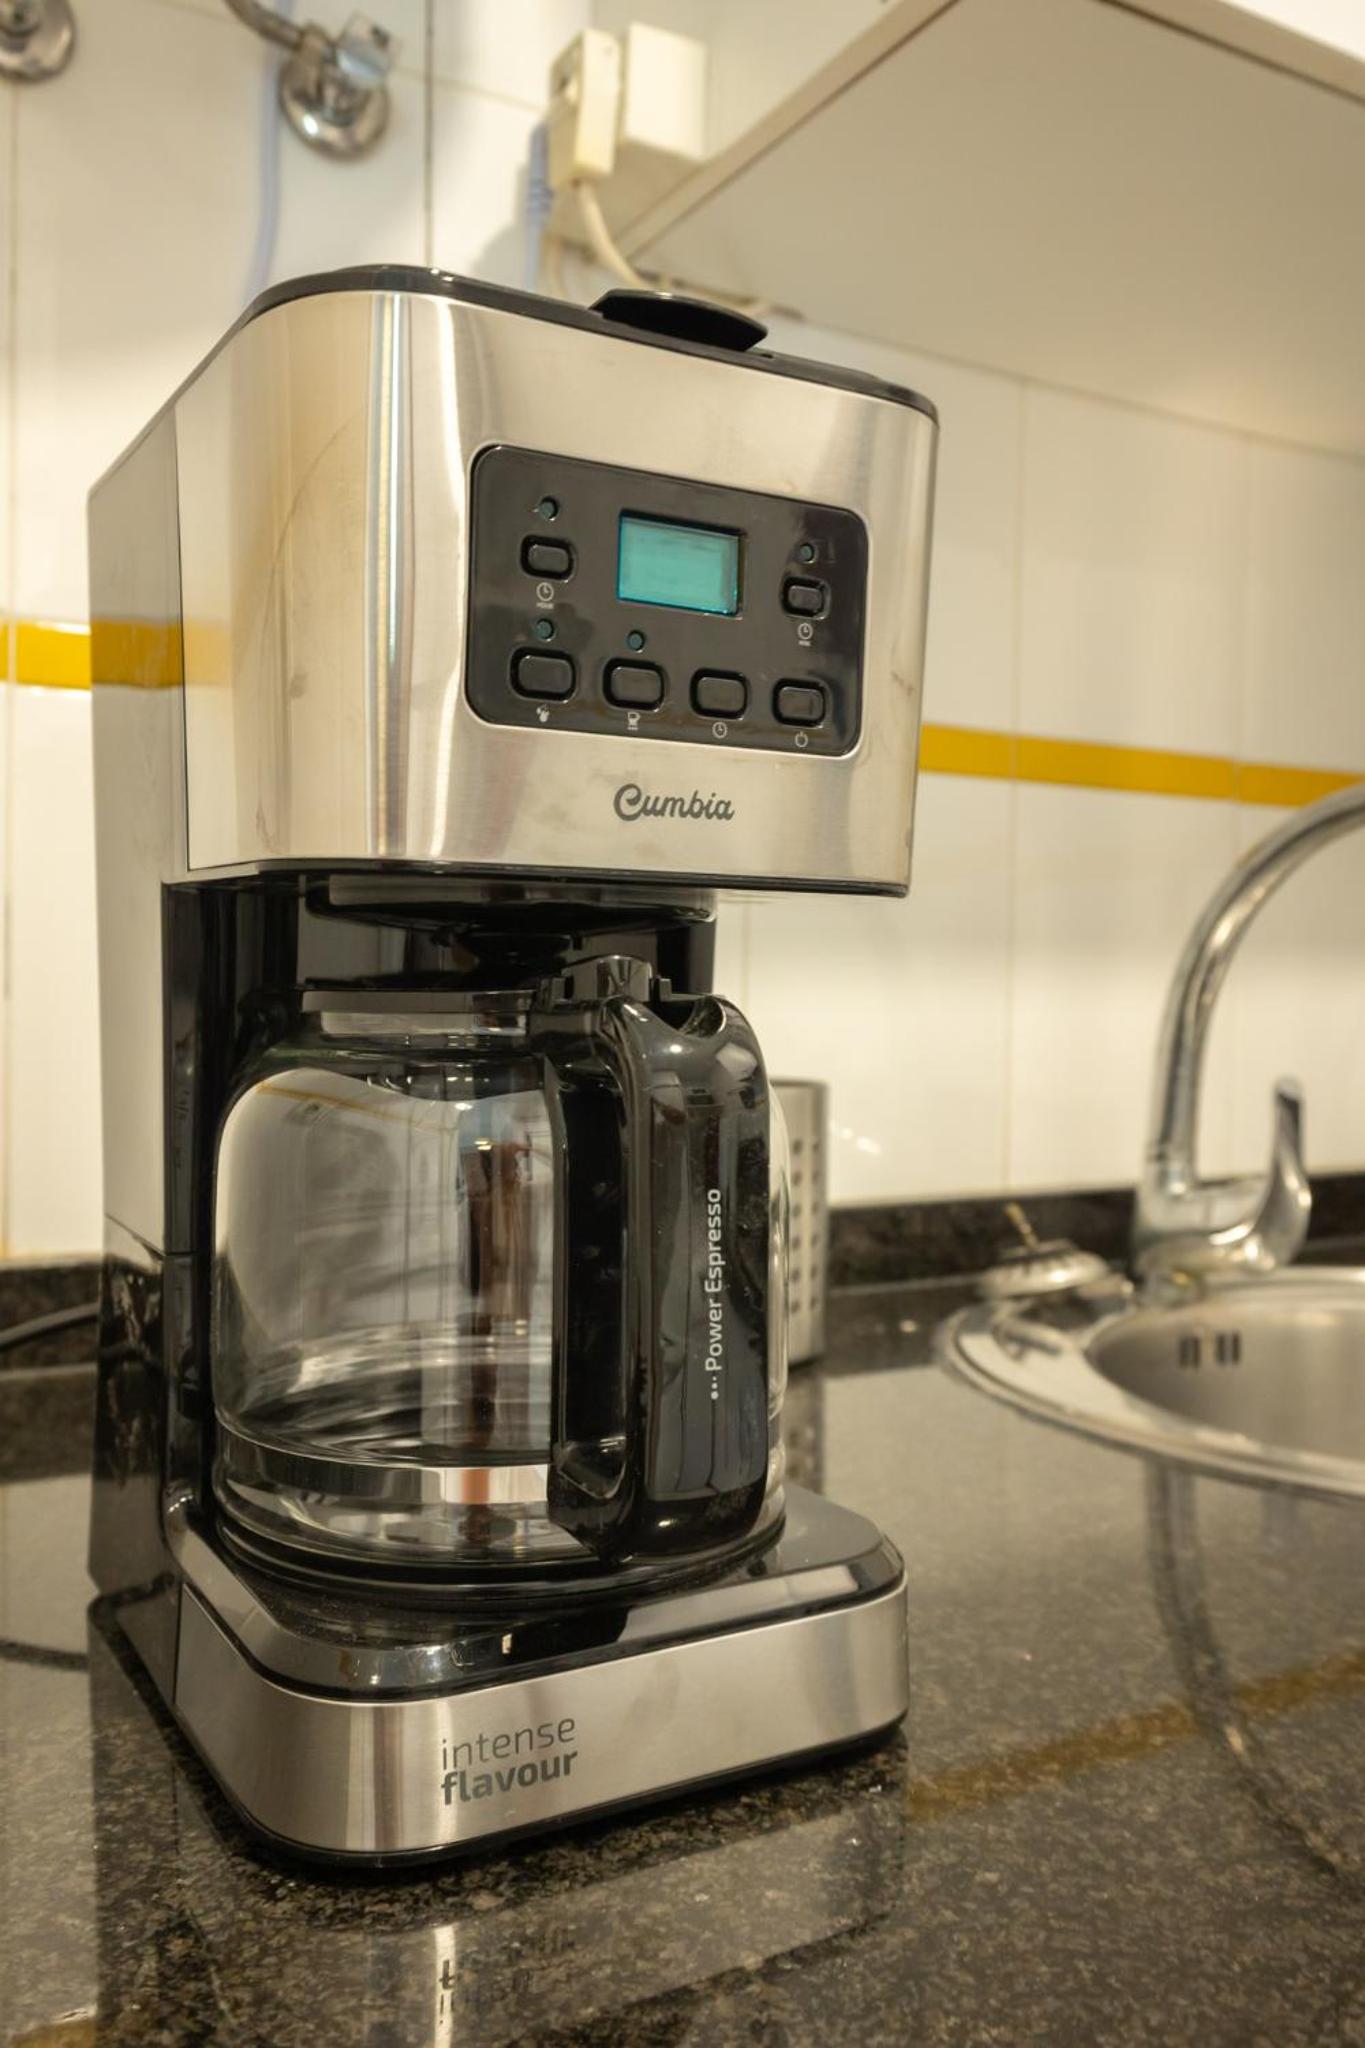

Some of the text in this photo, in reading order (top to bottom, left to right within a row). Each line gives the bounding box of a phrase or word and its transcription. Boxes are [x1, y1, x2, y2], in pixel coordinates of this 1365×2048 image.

[613, 783, 735, 821] Cumbia
[705, 1188, 726, 1372] Power Espresso
[442, 1718, 576, 1770] intense
[440, 1751, 578, 1806] flavour
